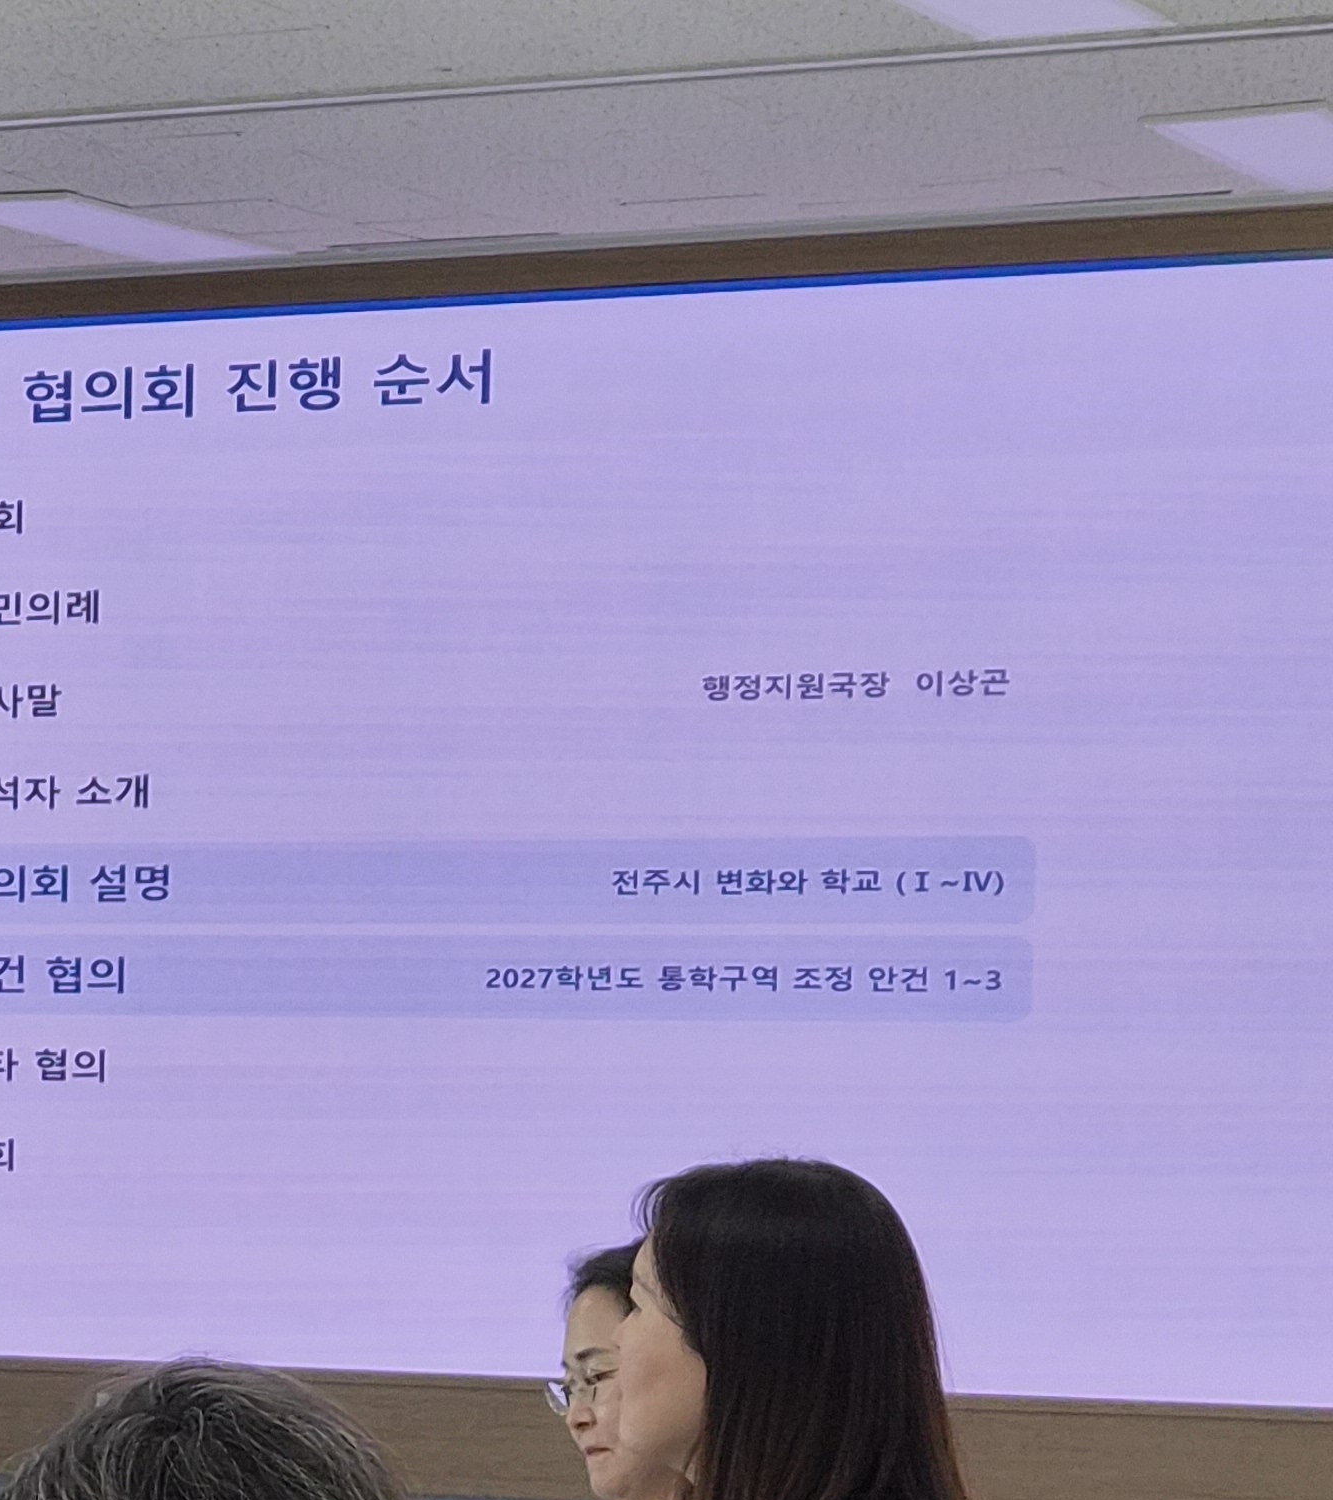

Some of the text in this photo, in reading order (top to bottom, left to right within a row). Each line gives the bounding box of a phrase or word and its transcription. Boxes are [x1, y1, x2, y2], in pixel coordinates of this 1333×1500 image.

[23, 348, 491, 424] 협의회 진행 순서
[702, 669, 1010, 702] 행정지원국장 이상곤
[76, 774, 149, 809] 소개
[90, 864, 169, 903] 설명
[612, 869, 700, 896] 전주시
[716, 869, 809, 895] 변화와
[820, 868, 882, 895] 학교
[46, 956, 125, 994] 협의
[486, 965, 1002, 993] 2027학년도 통학구역 조정 안건 1~3
[35, 1048, 106, 1083] 협의
